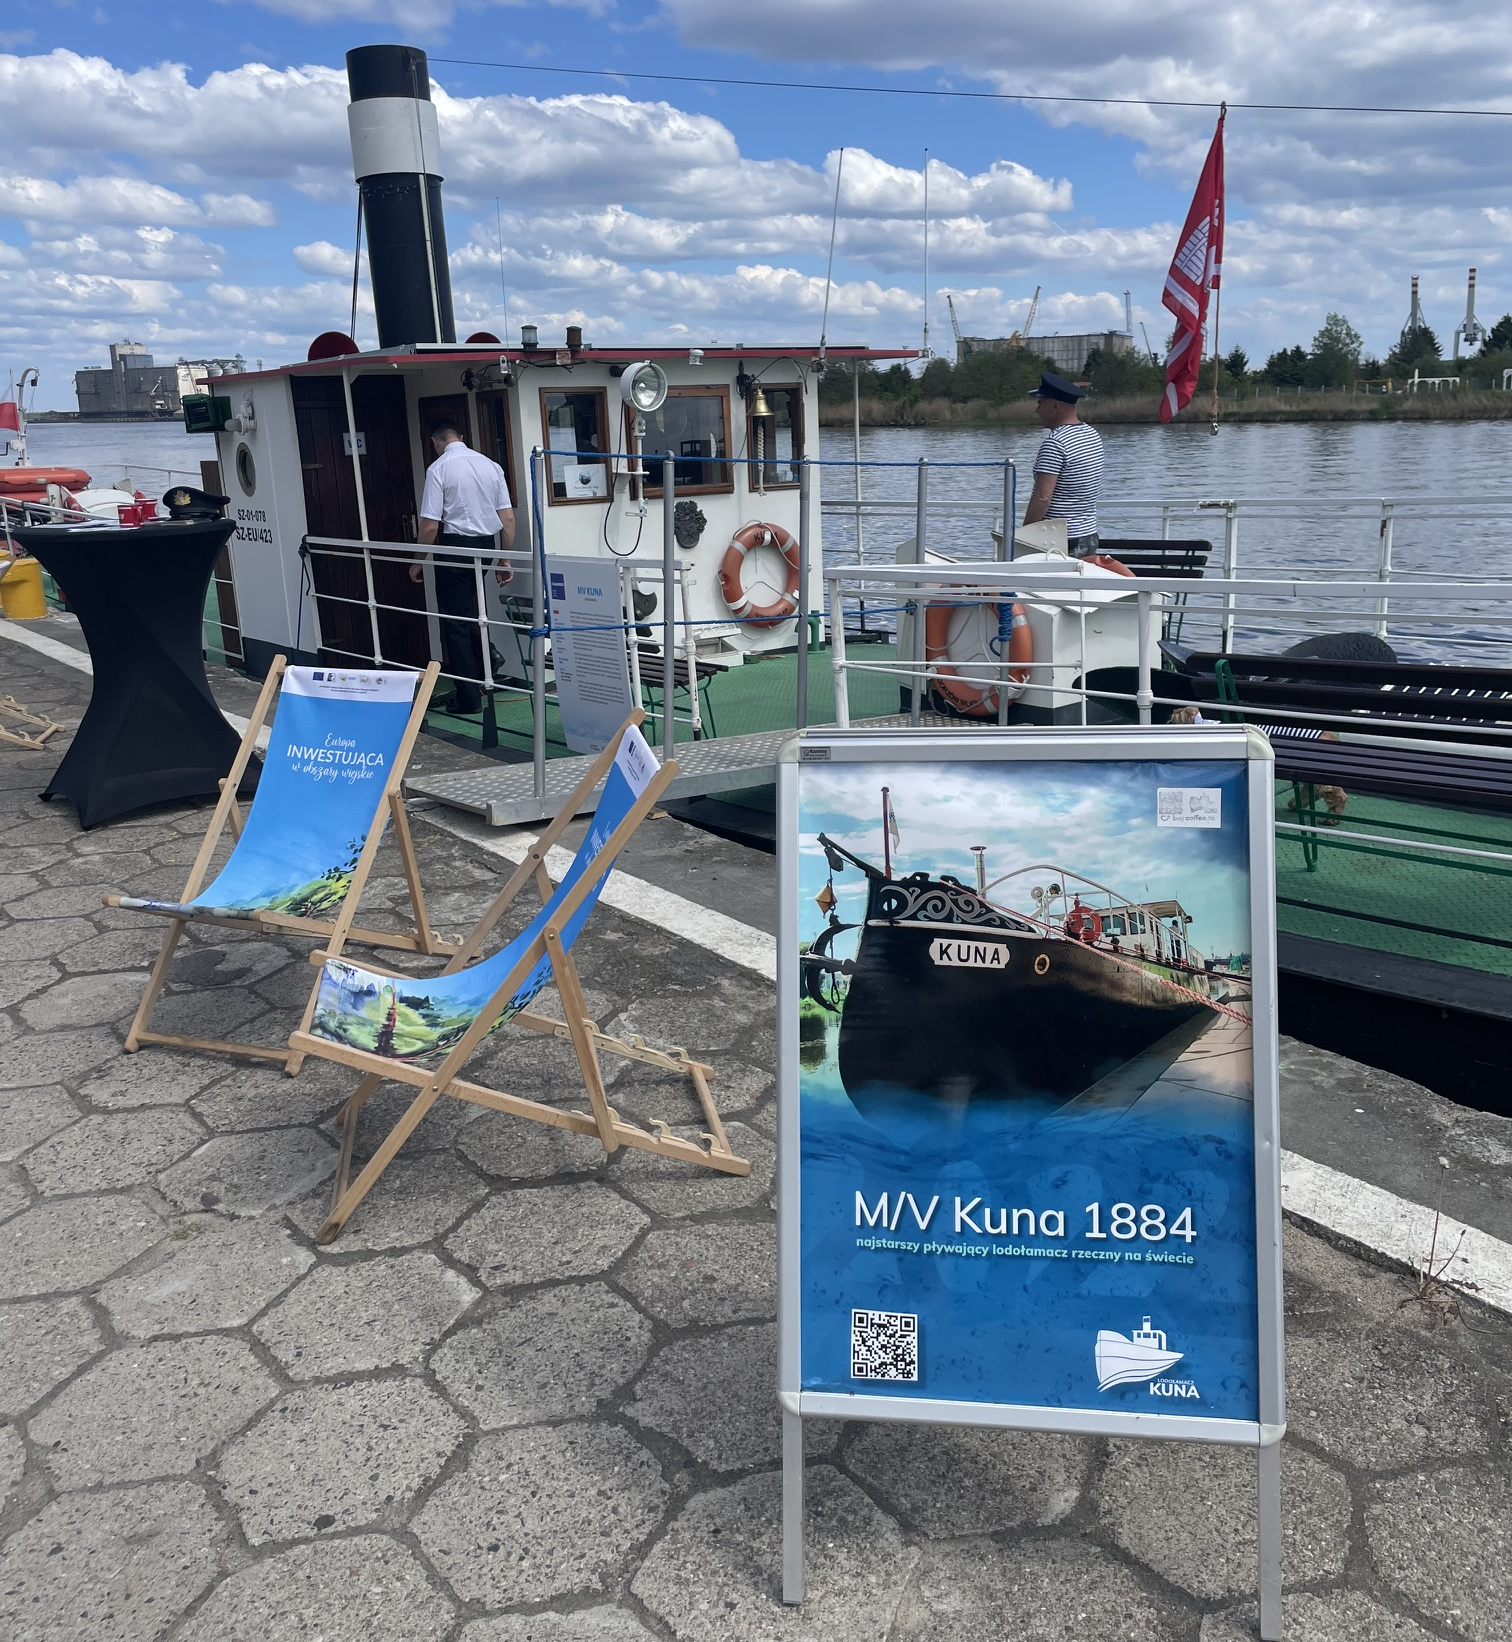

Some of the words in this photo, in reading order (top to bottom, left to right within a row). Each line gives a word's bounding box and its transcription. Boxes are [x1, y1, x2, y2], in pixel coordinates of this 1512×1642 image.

[237, 508, 267, 522] SZ-01-078
[325, 732, 357, 750] Europa
[287, 744, 384, 767] INWESTUJĄCA
[291, 761, 301, 772] w
[303, 760, 339, 783] obszary
[341, 764, 374, 785] wiejskie
[939, 942, 1001, 965] KUNA
[855, 1190, 940, 1231] M/V
[954, 1196, 1065, 1237] Kuna
[1085, 1201, 1198, 1243] 1884
[856, 1236, 920, 1253] najstarszy
[923, 1241, 989, 1257] pływający
[992, 1243, 1068, 1258] lodołamacz
[1071, 1248, 1121, 1262] rzeczny
[1125, 1250, 1142, 1261] na
[1145, 1249, 1194, 1264] świecie
[1149, 1382, 1200, 1398] KUNA
